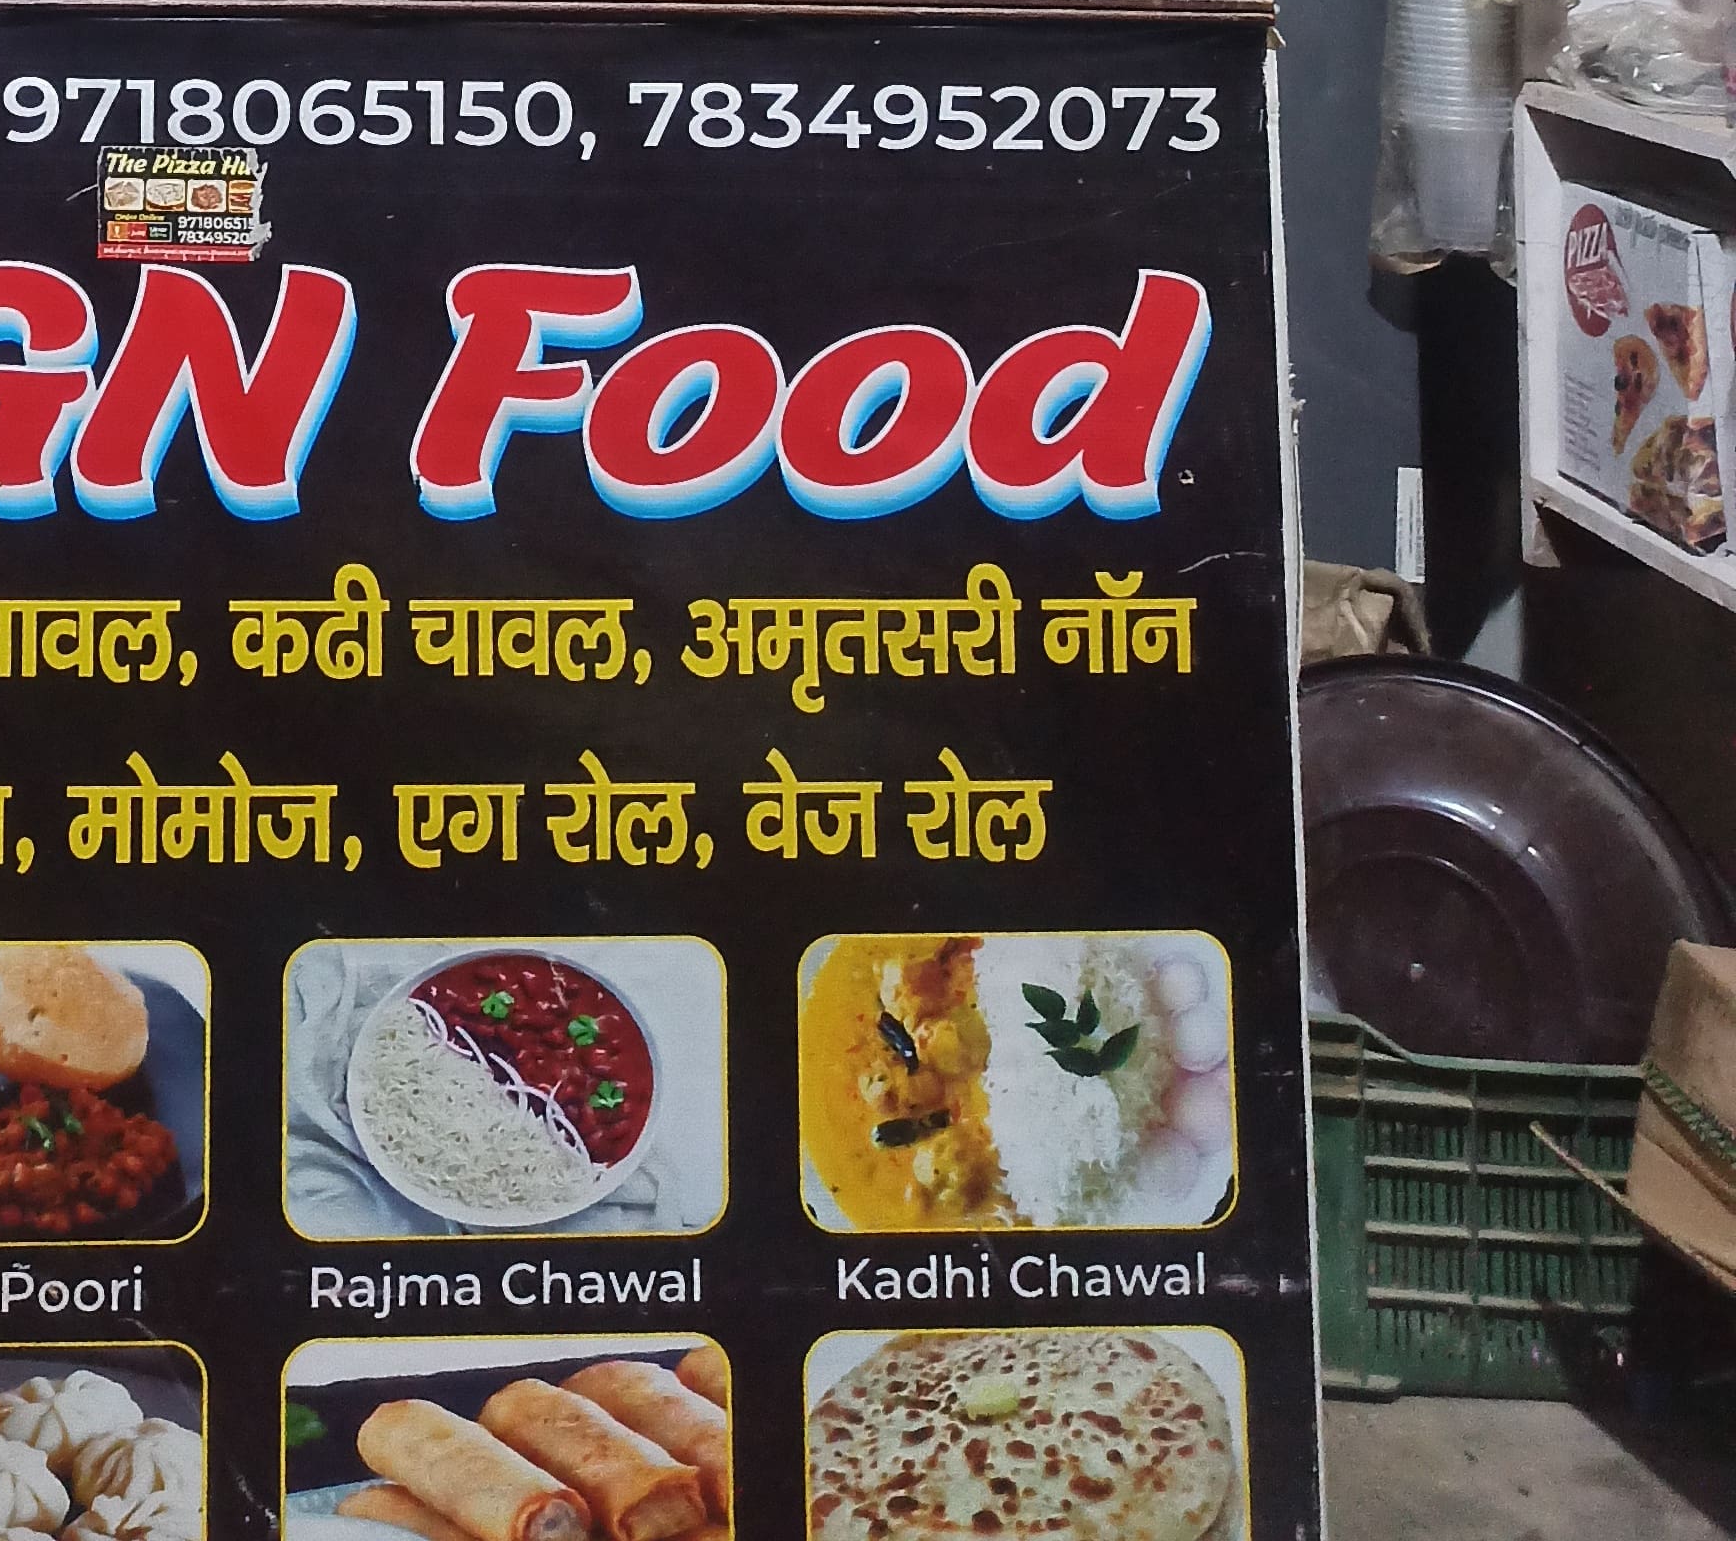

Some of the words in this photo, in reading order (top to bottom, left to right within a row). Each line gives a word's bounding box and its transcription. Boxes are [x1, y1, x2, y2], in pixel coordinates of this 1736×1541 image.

[3, 77, 597, 161] 9718065150,
[627, 81, 1221, 153] 7834952073
[107, 153, 145, 174] The
[152, 154, 216, 174] Pizza
[221, 156, 252, 175] Hu
[1568, 222, 1609, 267] PIZZA
[409, 262, 1212, 519] Food
[411, 597, 650, 687] चावल,
[682, 563, 1022, 713] अमृतसरी
[1041, 570, 1196, 674] नॉन
[67, 749, 361, 872] मोमोज,
[394, 782, 524, 869] एग
[546, 748, 715, 869] रोल,
[744, 748, 882, 861] वेज
[905, 748, 1053, 862] रोल
[1, 1262, 144, 1314] Poori
[310, 1264, 484, 1320] Rajma
[502, 1259, 702, 1305] Chawal
[836, 1253, 991, 1300] Kadhi
[1009, 1251, 1205, 1299] Chawal
